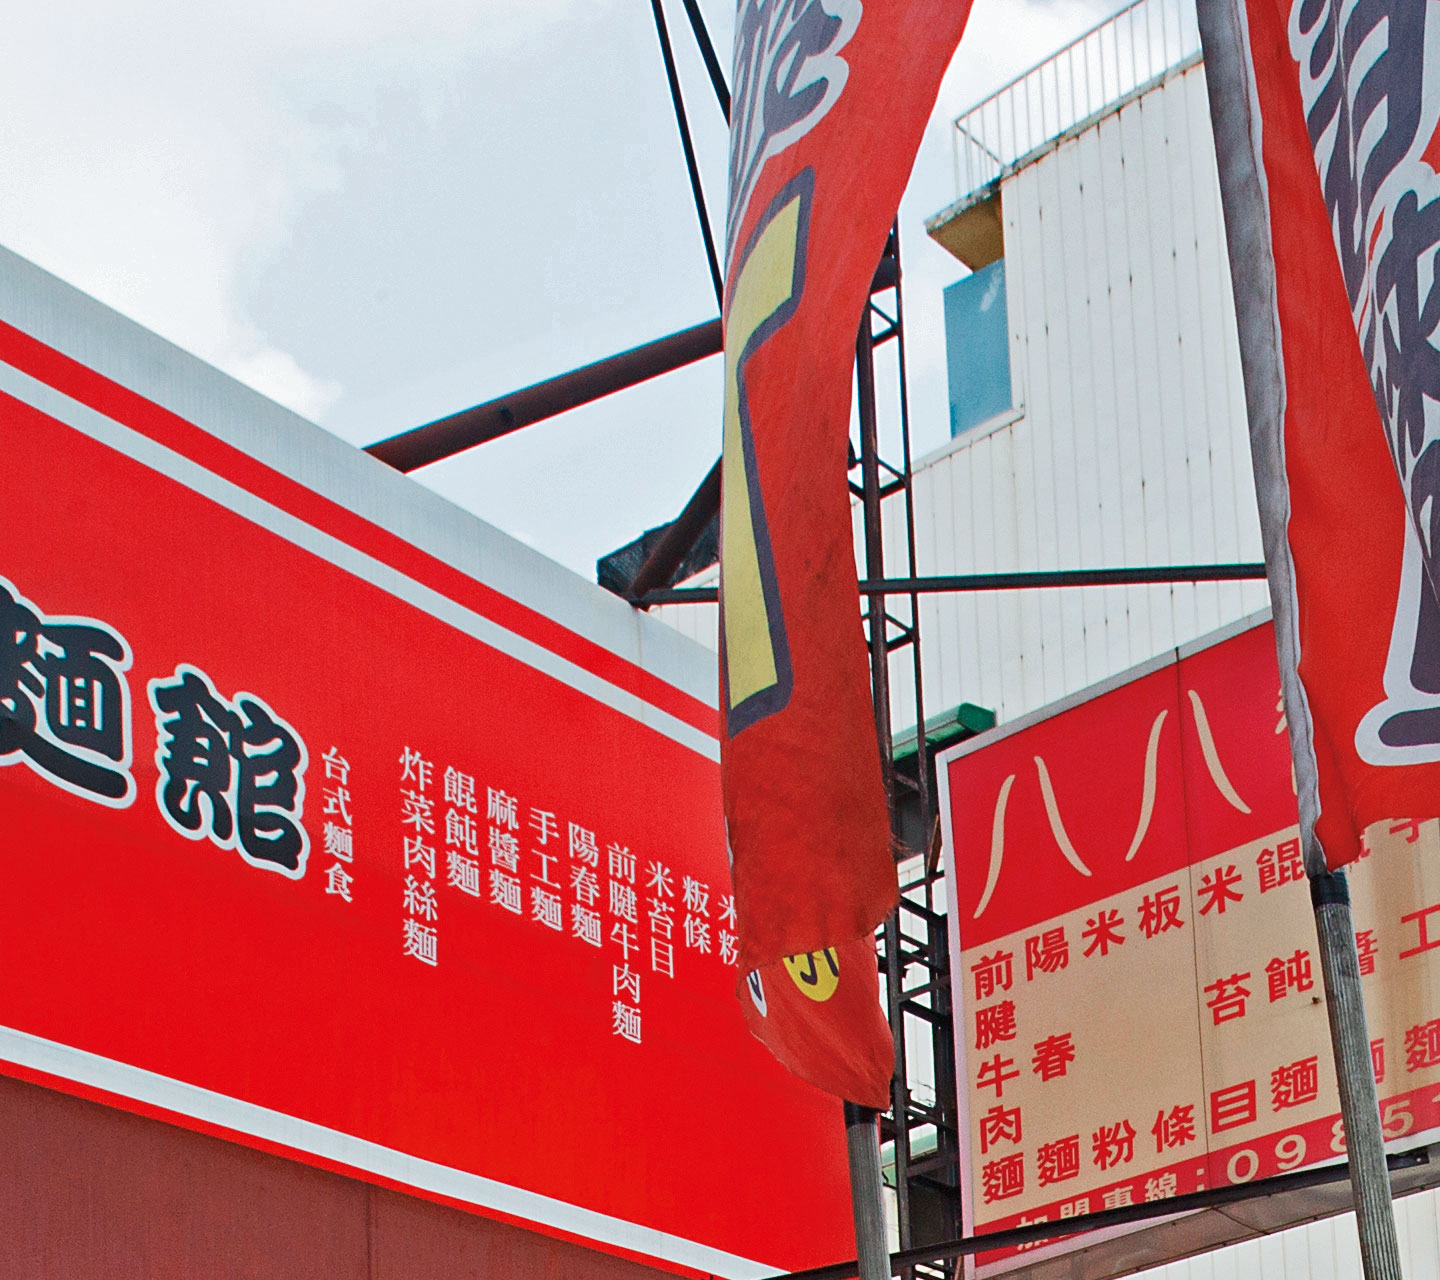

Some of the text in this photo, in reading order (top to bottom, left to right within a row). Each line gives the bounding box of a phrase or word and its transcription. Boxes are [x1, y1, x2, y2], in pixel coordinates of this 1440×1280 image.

[320, 745, 354, 905] 台式麵食
[398, 745, 439, 968] 炸菜肉絲麵
[443, 764, 481, 899] 餛飩麵
[485, 784, 524, 916] 麻醬麵
[527, 806, 564, 932] 手工麵
[567, 821, 603, 949] 陽春麵
[604, 842, 643, 1046] 前腱牛肉麵
[644, 861, 676, 980] 米苔目
[717, 894, 740, 969] 米粉
[1196, 866, 1258, 1132] 米苔目
[1256, 837, 1320, 1115] 餛飩麵
[970, 951, 1027, 1206] 前腱牛肉麵
[1023, 915, 1080, 1187] 陽春麵
[1081, 902, 1137, 1168] 米粉
